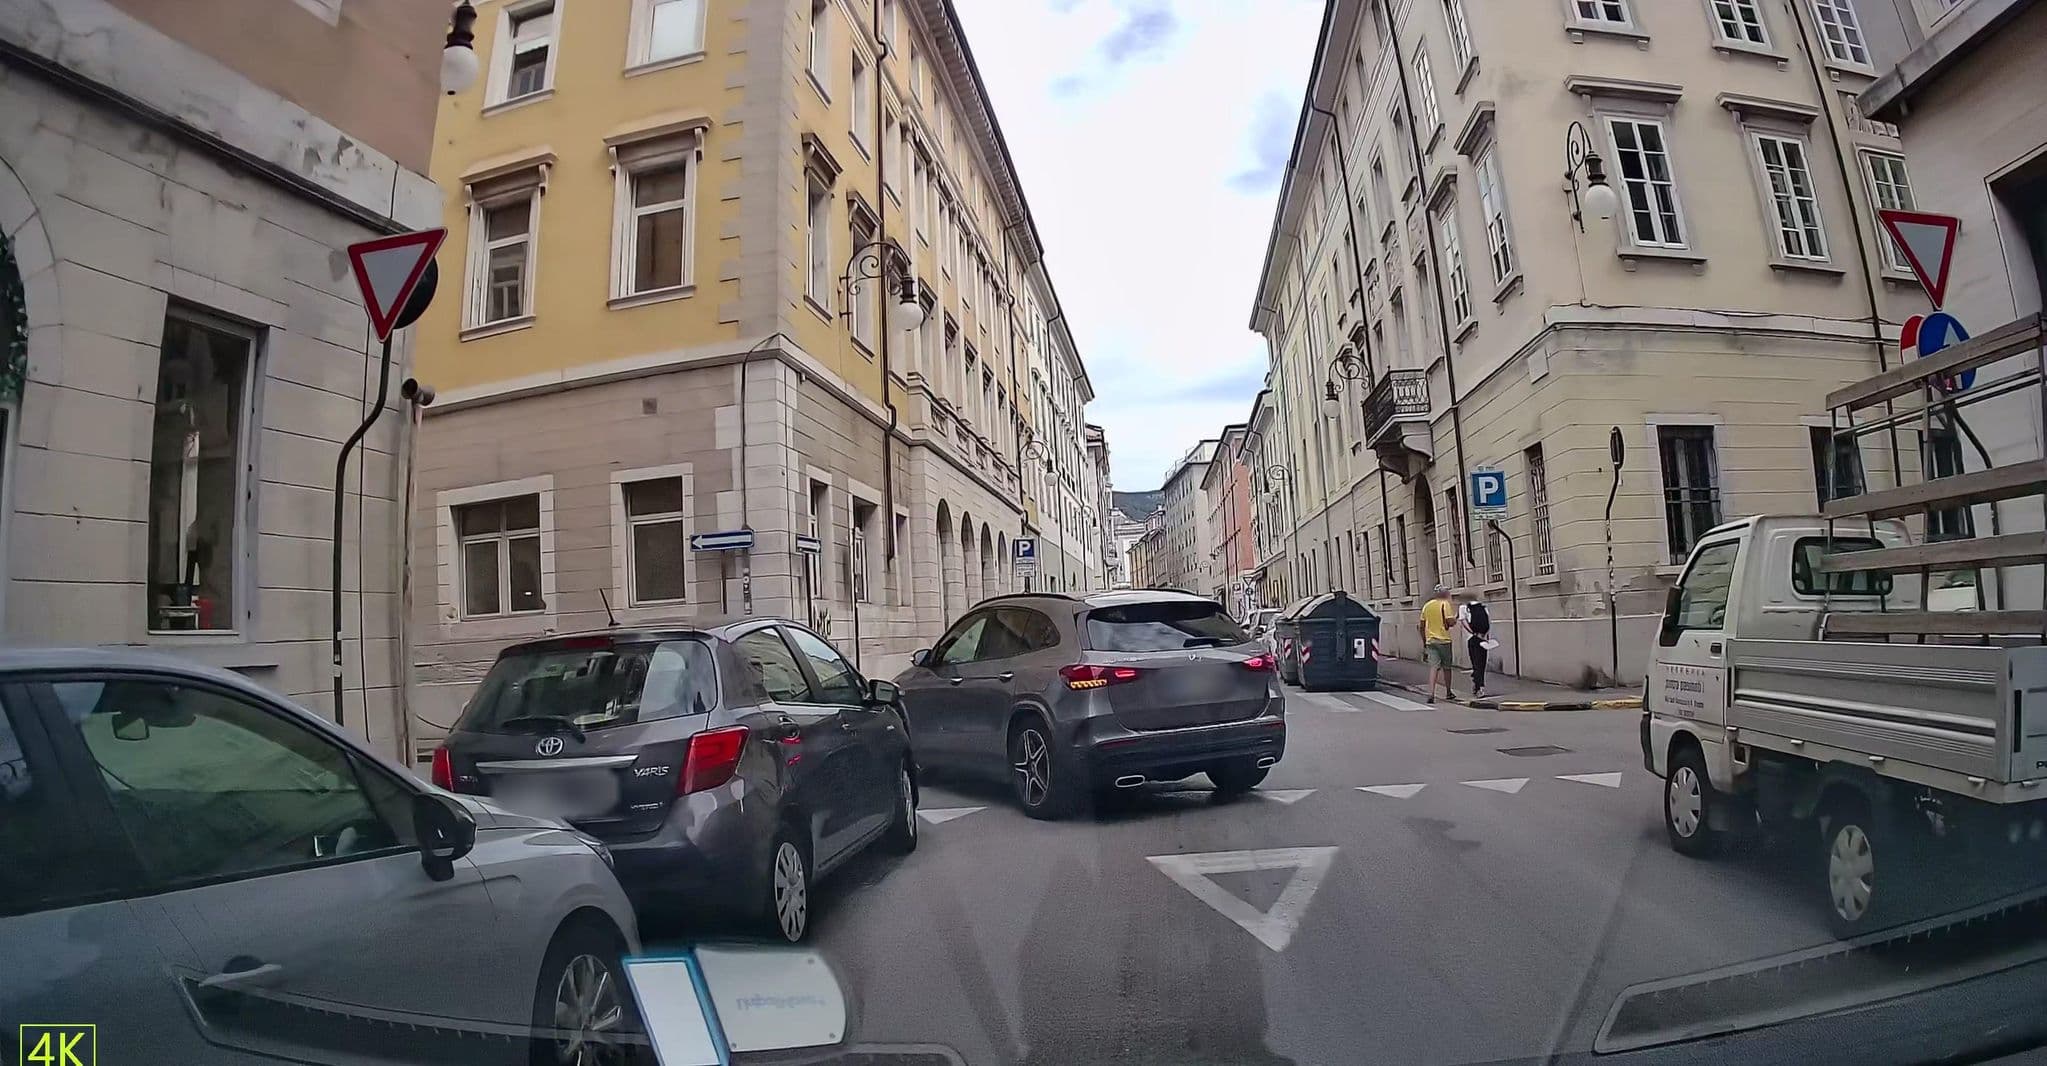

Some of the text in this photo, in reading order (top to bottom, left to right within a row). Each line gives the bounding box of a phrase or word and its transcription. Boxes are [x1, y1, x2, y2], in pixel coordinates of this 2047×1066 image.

[1478, 476, 1499, 504] P
[1018, 540, 1031, 557] P
[633, 766, 670, 778] YARIS
